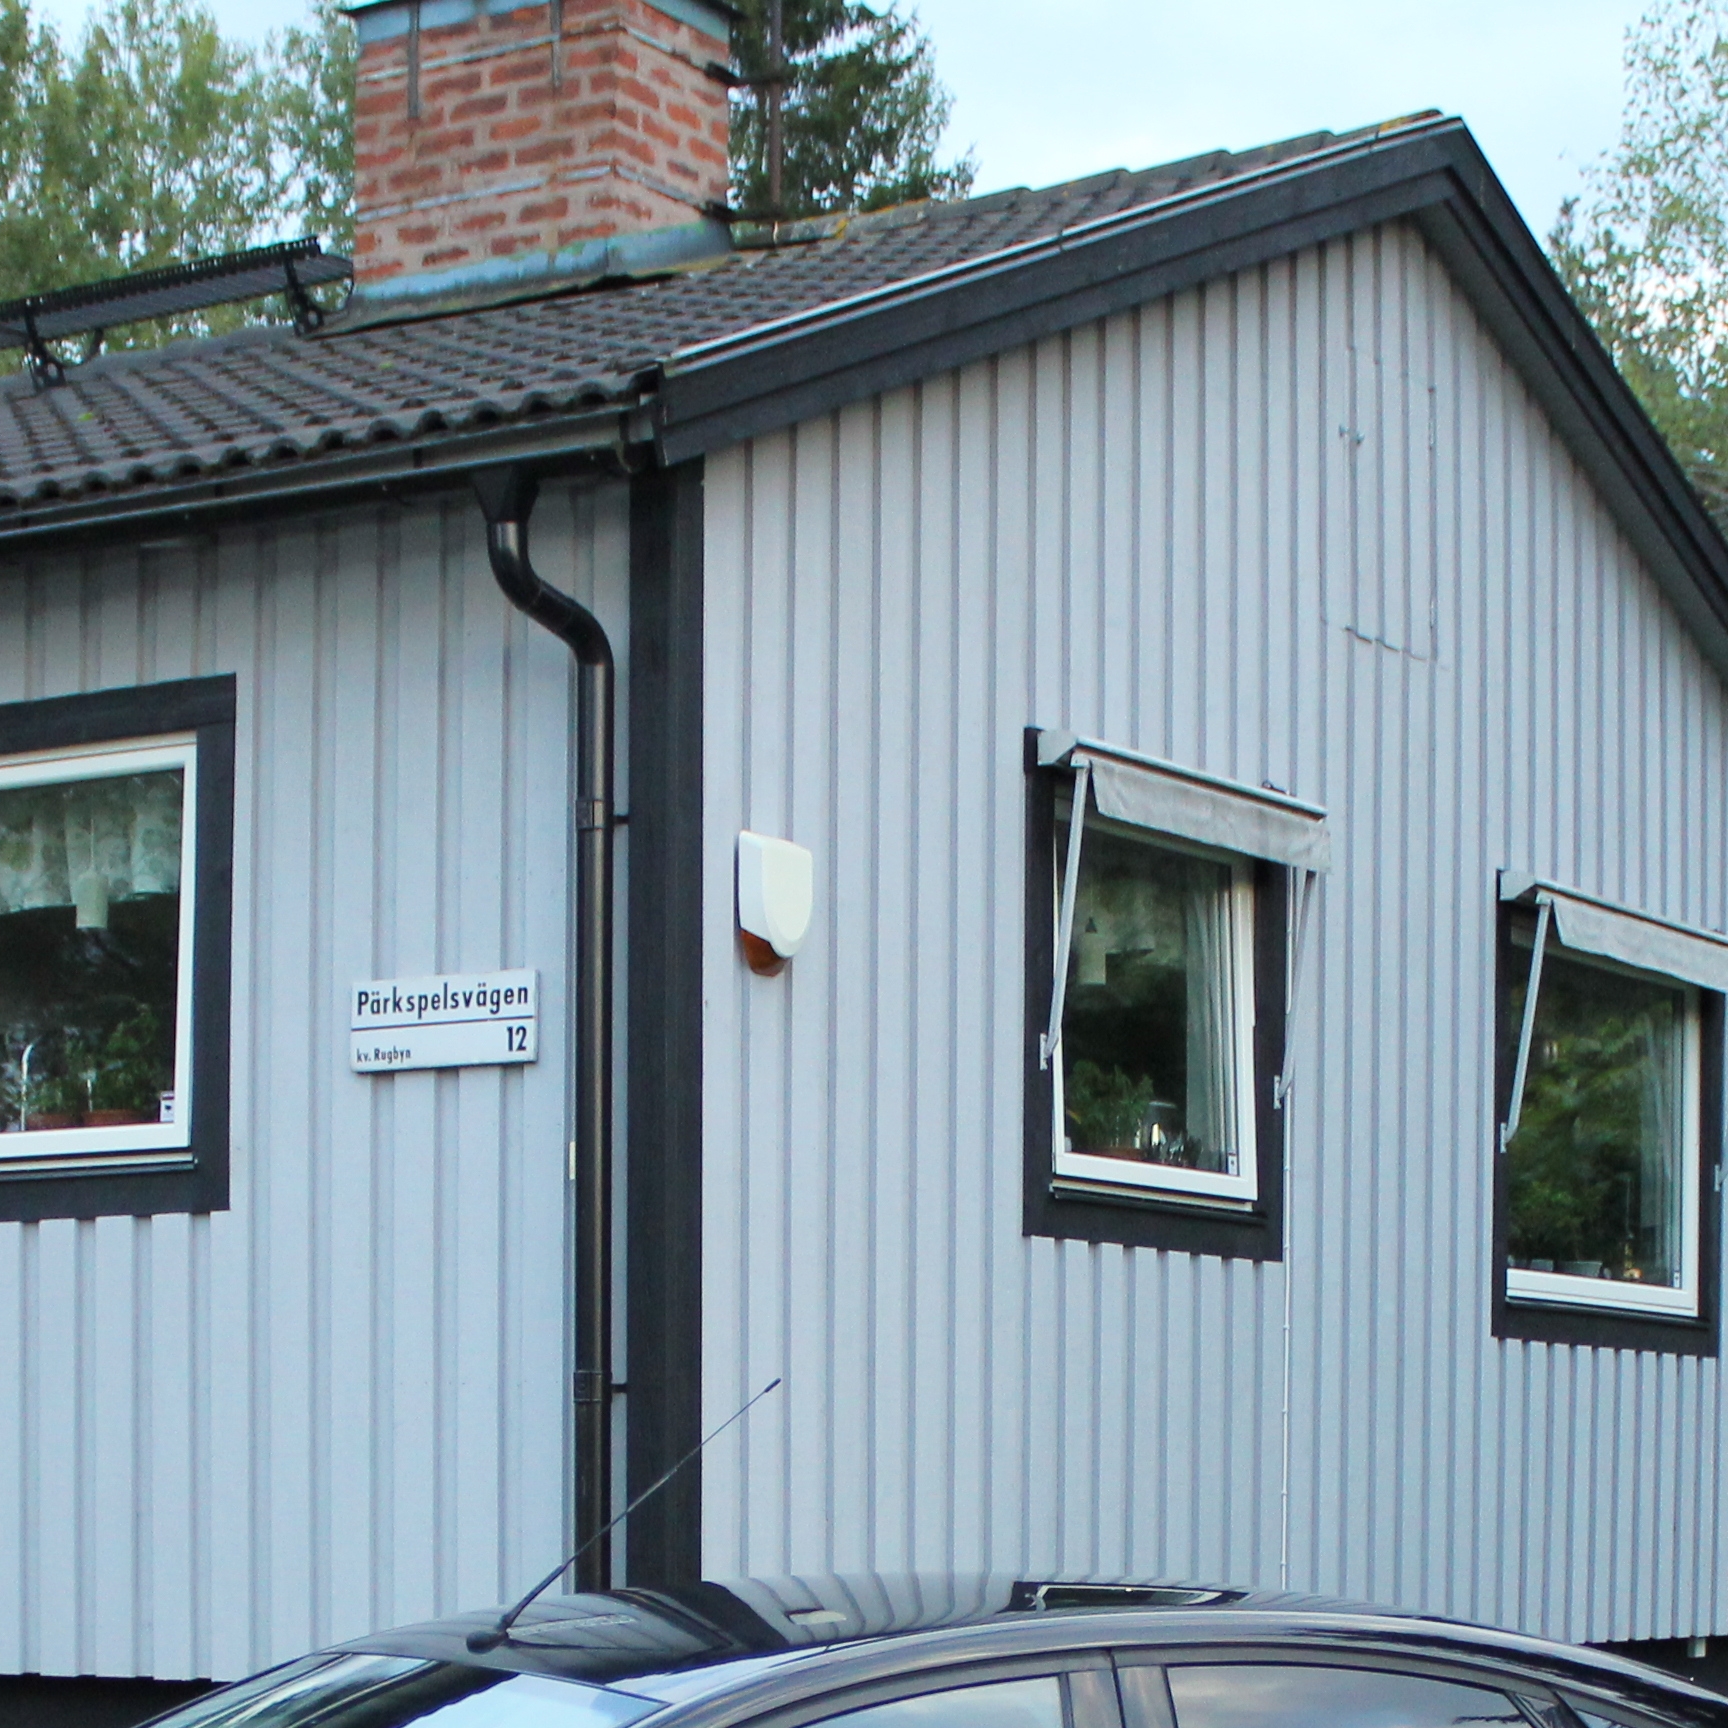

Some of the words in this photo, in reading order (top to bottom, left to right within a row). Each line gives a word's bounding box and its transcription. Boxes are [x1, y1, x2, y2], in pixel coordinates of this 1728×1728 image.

[356, 983, 529, 1020] Pärkspelsvägen
[506, 1025, 527, 1052] 12
[356, 1049, 371, 1062] kv.
[374, 1046, 411, 1064] Rugbyn
